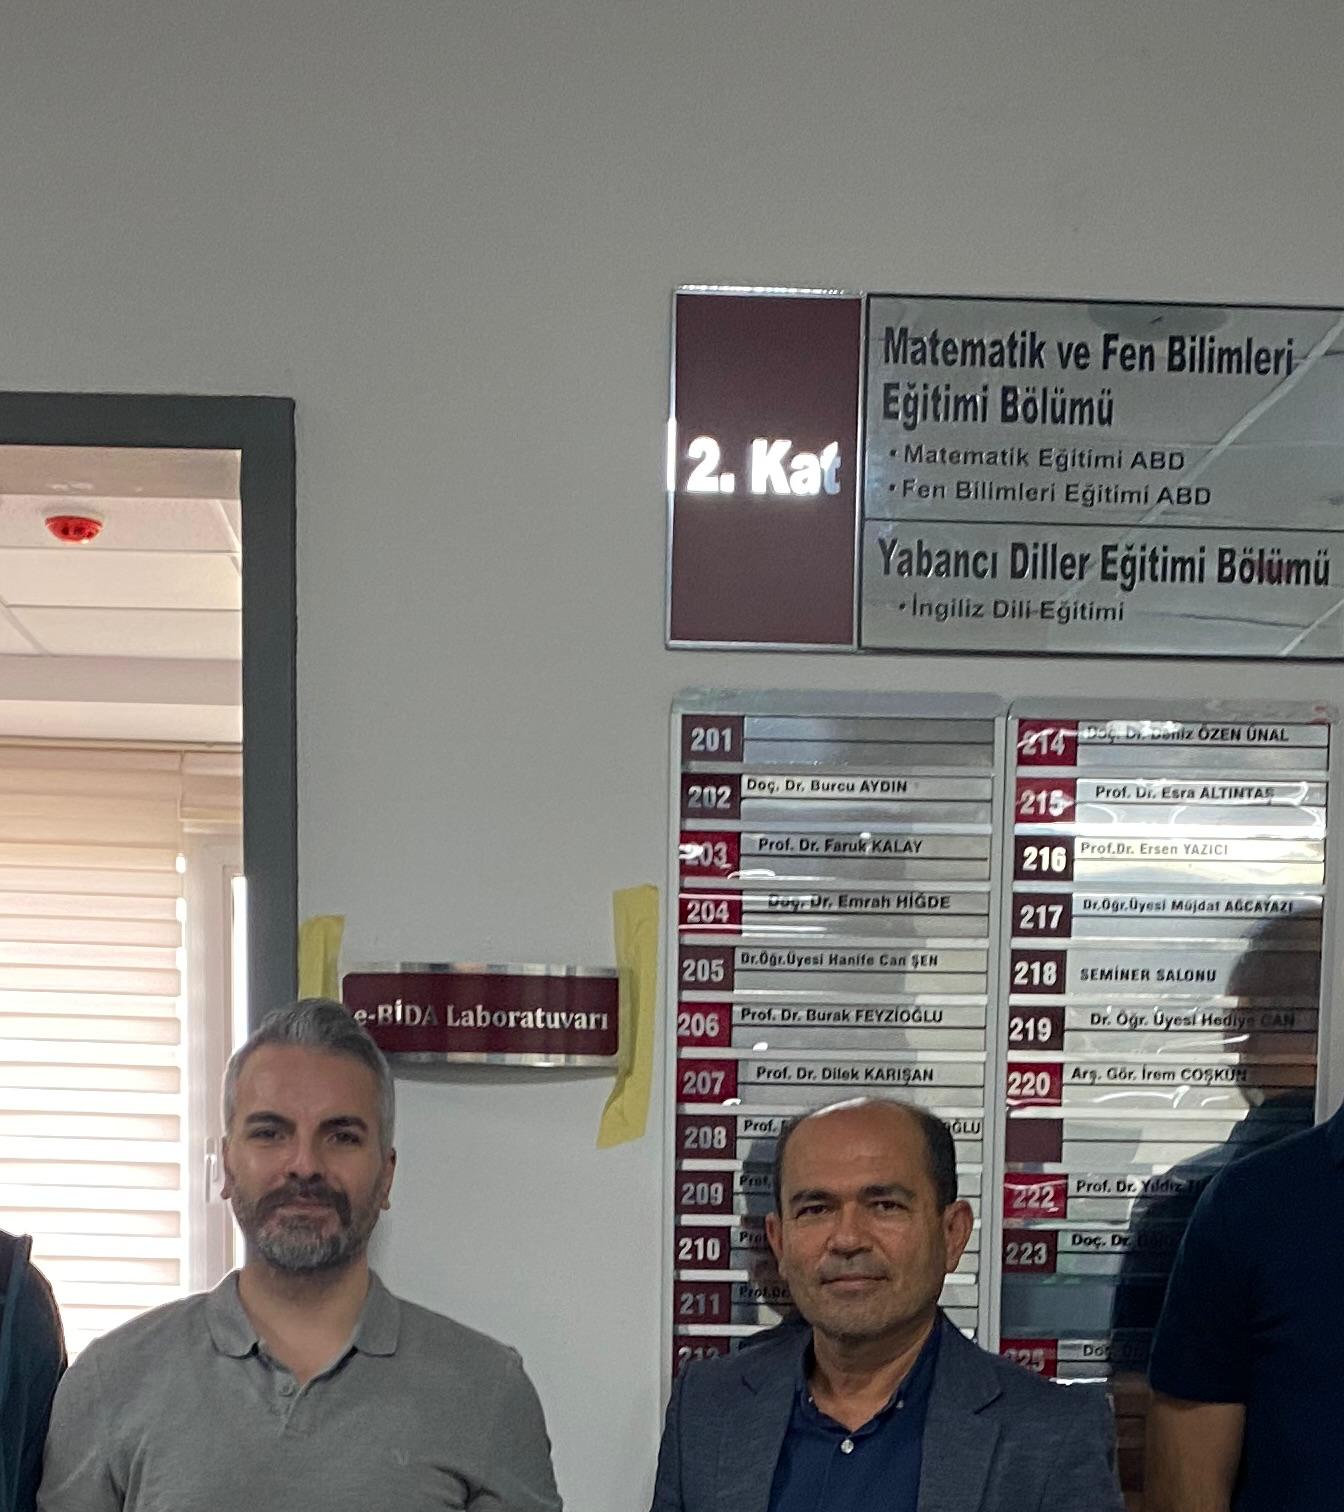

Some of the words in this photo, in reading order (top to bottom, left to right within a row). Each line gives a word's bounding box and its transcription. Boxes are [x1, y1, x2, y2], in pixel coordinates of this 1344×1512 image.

[883, 326, 1047, 371] Matematik
[1056, 339, 1091, 371] ve
[1102, 339, 1155, 373] Fen
[1167, 334, 1296, 376] Bilimleri
[882, 382, 989, 426] Eğitimi
[1001, 384, 1114, 427] Bölümü
[686, 436, 735, 494] 2.
[751, 437, 842, 496] Kat
[903, 445, 1030, 469] Matematik
[1039, 447, 1124, 472] Eğitimi
[1130, 451, 1186, 471] ABD
[902, 479, 947, 499] Fen
[955, 481, 1056, 503] Bilimleri
[1064, 482, 1149, 508] Eğitimi
[1156, 486, 1212, 506] ABD
[878, 537, 998, 580] Yabancı
[1010, 541, 1091, 582] Diller
[1101, 544, 1206, 591] Eğitimi
[1217, 546, 1331, 587] Bölümü
[911, 593, 985, 623] İngiliz
[992, 599, 1031, 620] Dili
[1039, 600, 1125, 625] Eğitimi
[691, 727, 733, 752] 201
[1198, 723, 1242, 742] ÖZEN
[1246, 723, 1289, 742] ÜNAL
[687, 785, 732, 809] 202
[747, 778, 780, 794] Doç.
[810, 780, 855, 793] Burcu
[859, 780, 908, 794] AYDIN
[1019, 789, 1065, 817] 215
[1095, 785, 1128, 799] Prof.
[1161, 787, 1196, 799] Esra
[758, 838, 794, 853] Prof.
[799, 839, 820, 852] Dr.
[824, 839, 868, 853] Faruk
[872, 840, 923, 853] KALAY
[1022, 846, 1067, 872] 216
[1140, 843, 1178, 856] Ersen
[686, 901, 729, 923] 204
[838, 895, 890, 909] Emrah
[895, 890, 952, 909] HİĞDE
[1020, 904, 1063, 929] 217
[682, 959, 725, 982] 205
[828, 953, 874, 967] Hanife
[879, 955, 907, 967] Can
[910, 955, 938, 969] ŞEN
[1013, 960, 1057, 986] 218
[1080, 964, 1150, 981] SEMİNER
[1156, 968, 1217, 982] SALONU
[446, 1003, 609, 1031] Laboratuvarı
[677, 1013, 720, 1037] 206
[740, 1008, 776, 1022] Prof.
[781, 1009, 802, 1022] Dr.
[806, 1009, 850, 1022] Burak
[855, 1006, 944, 1023] FEYZİOĞLU
[1009, 1017, 1052, 1042] 219
[1090, 1013, 1112, 1026] Dr.
[682, 1070, 725, 1095] 207
[756, 1065, 792, 1080] Prof.
[796, 1067, 817, 1080] Dr.
[821, 1067, 860, 1081] Dilek
[864, 1067, 934, 1085] KARIŞAN
[1007, 1072, 1051, 1096] 220
[1141, 1065, 1175, 1081] İrem
[684, 1125, 727, 1149] 208
[743, 1119, 777, 1133] Prof.
[681, 1182, 724, 1206] 209
[1012, 1184, 1056, 1209] 222
[1076, 1179, 1112, 1193] Prof.
[1116, 1180, 1137, 1192] Dr.
[678, 1237, 721, 1261] 210
[1005, 1242, 1048, 1265] 223
[1071, 1233, 1106, 1247] Doç.
[679, 1292, 721, 1315] 211
